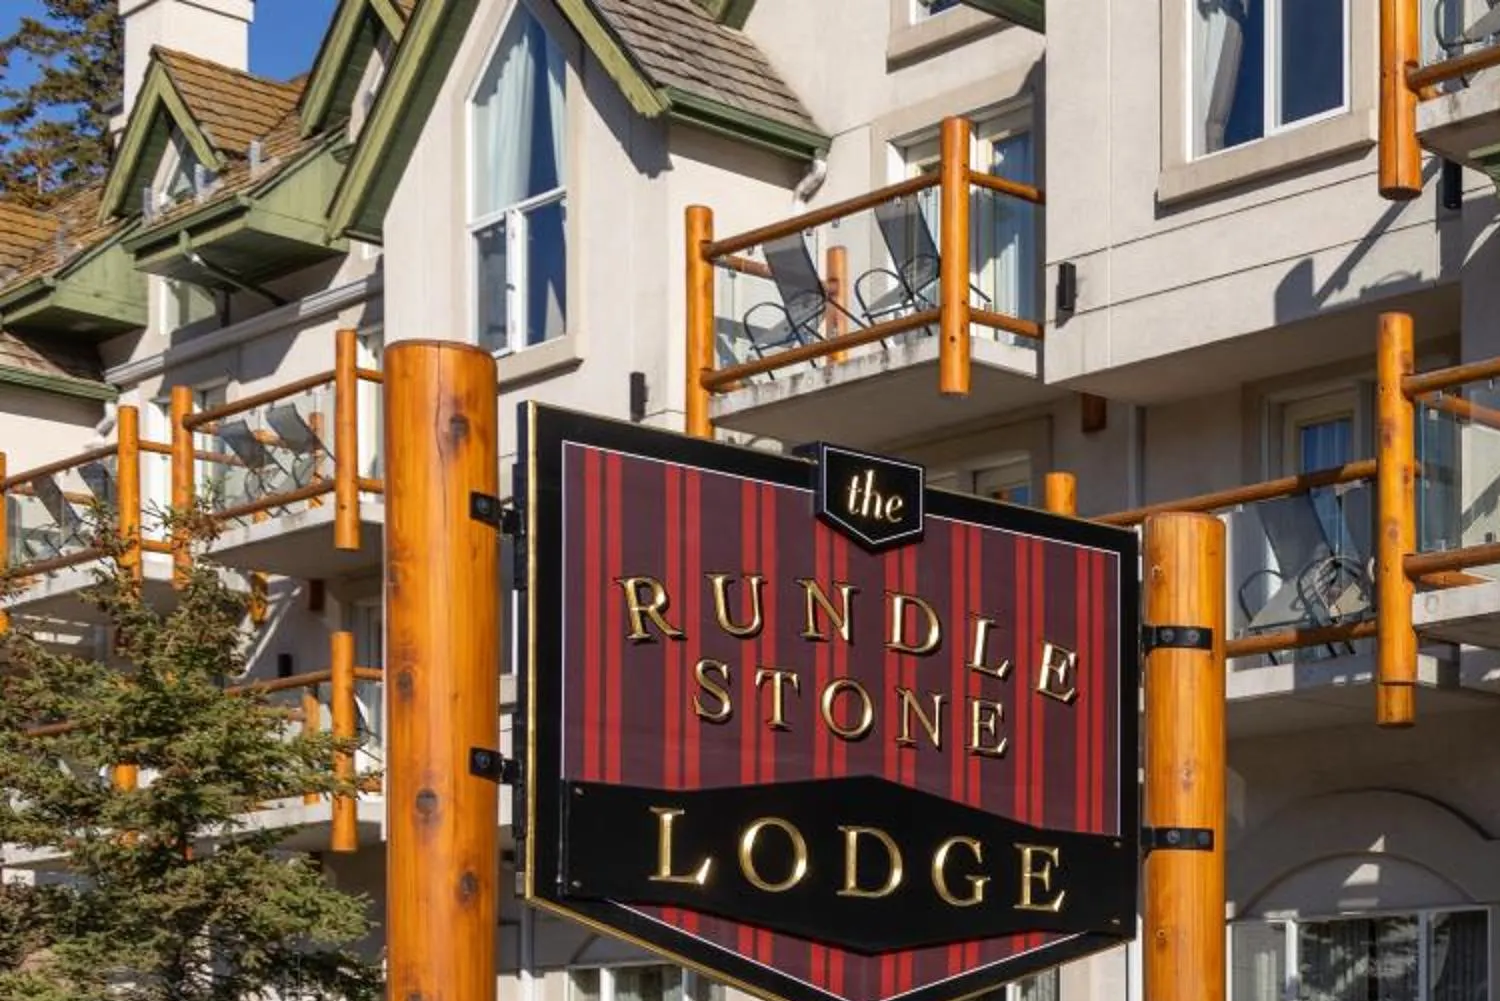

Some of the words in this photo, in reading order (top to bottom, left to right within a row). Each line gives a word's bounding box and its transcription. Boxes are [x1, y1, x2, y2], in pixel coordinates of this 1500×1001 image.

[846, 469, 904, 523] the
[617, 572, 1080, 703] RUNDLE
[693, 658, 1009, 757] STONE
[648, 806, 1067, 914] LODGE
